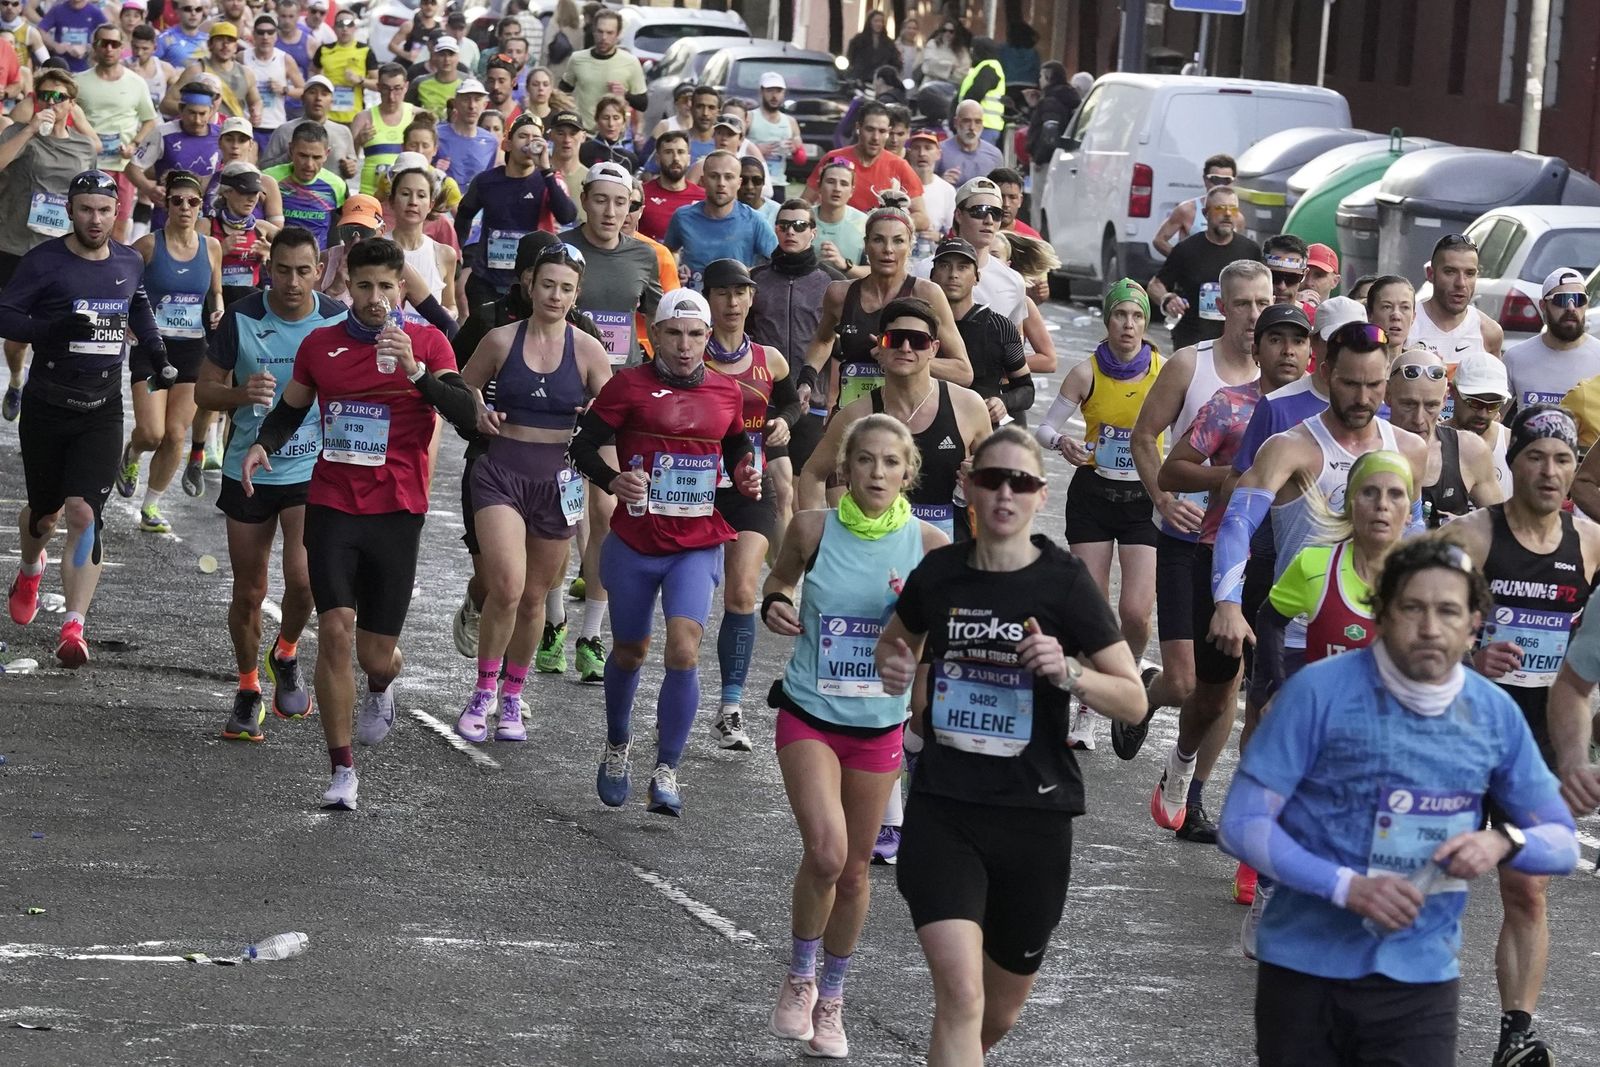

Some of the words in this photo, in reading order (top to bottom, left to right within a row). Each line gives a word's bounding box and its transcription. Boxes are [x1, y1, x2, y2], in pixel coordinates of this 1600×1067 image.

[36, 214, 65, 227] RIENER
[92, 302, 123, 310] ZURICH
[95, 318, 110, 327] 715
[596, 314, 626, 323] ZURICH
[602, 330, 614, 338] 355
[345, 404, 383, 418] ZURICH
[344, 422, 364, 433] 9139
[285, 441, 317, 457] JESÚS
[325, 438, 352, 449] RAMOS
[354, 440, 386, 453] ROJAS
[676, 476, 697, 486] 8199
[650, 488, 663, 501] EL
[911, 507, 947, 518] ZURICH
[958, 607, 993, 616] BELGIUM
[1518, 612, 1563, 628] ZURICH
[1514, 636, 1540, 649] 9056
[853, 646, 874, 658] 718
[967, 648, 987, 659] THAN
[1514, 652, 1563, 670] NYENT
[967, 668, 1021, 685] ZURICH
[969, 692, 999, 708] 9482
[947, 708, 1017, 734] HELENE
[1371, 853, 1417, 870] MARIA
